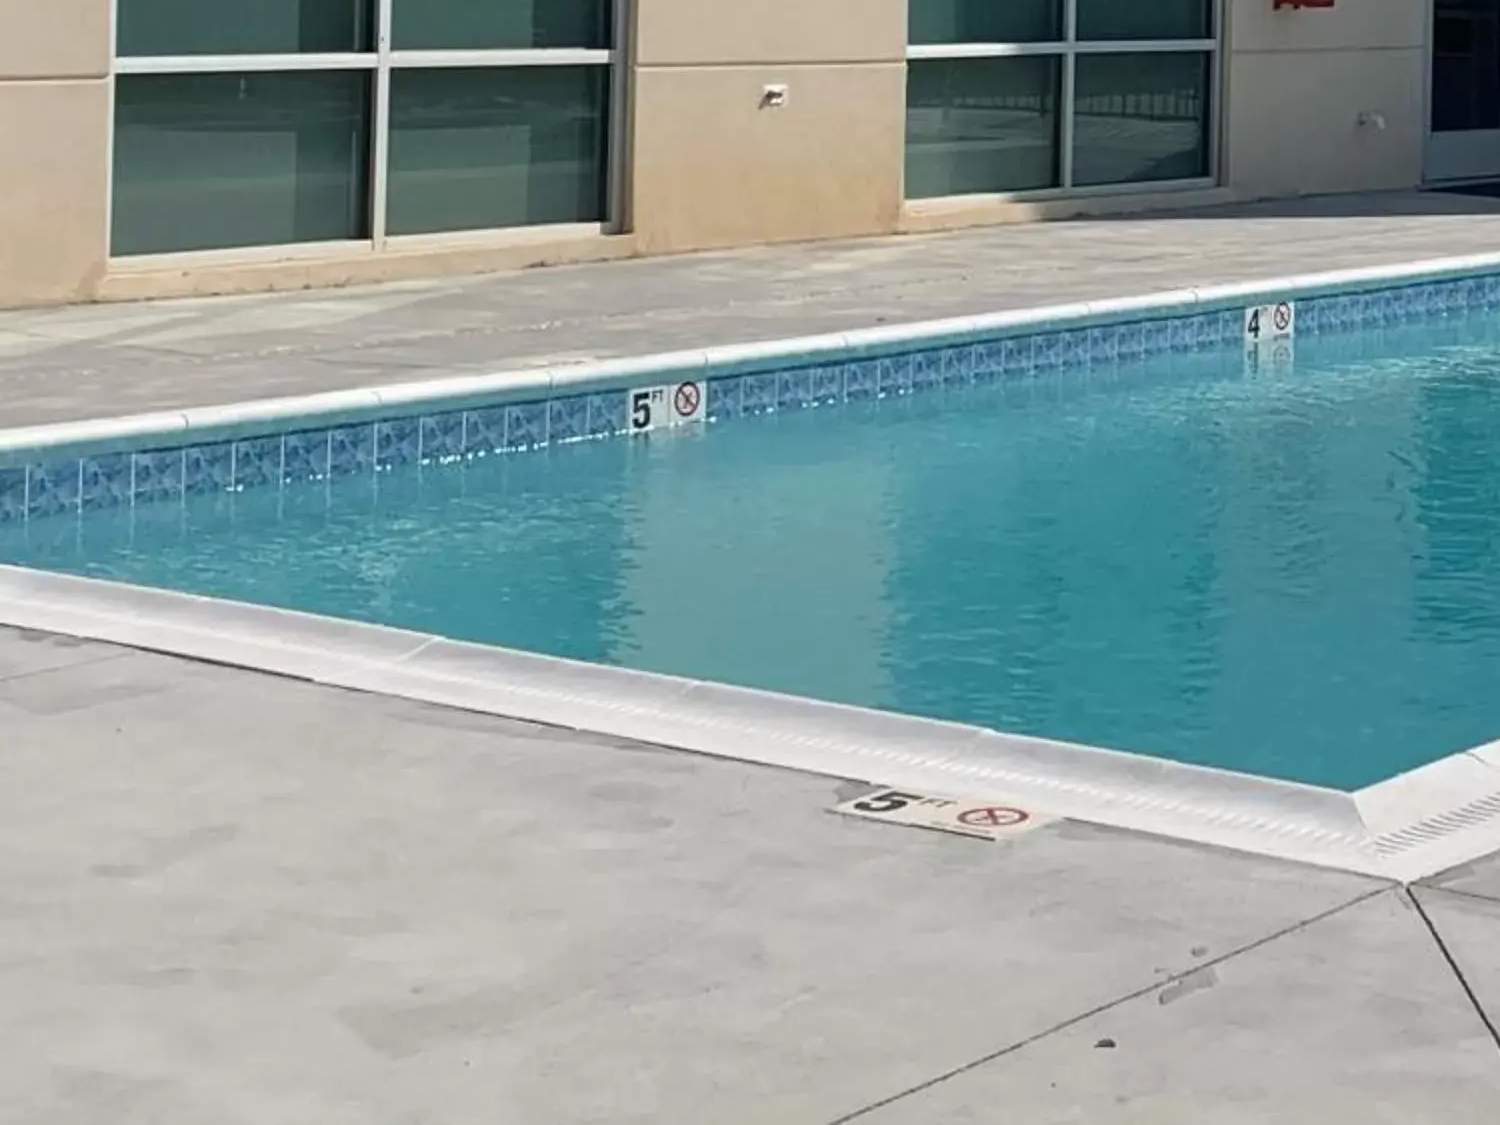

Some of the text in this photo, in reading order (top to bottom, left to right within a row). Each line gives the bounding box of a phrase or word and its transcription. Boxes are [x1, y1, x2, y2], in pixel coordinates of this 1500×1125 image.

[1247, 308, 1260, 338] 4
[632, 388, 664, 428] 5 FT
[853, 791, 925, 812] 5
